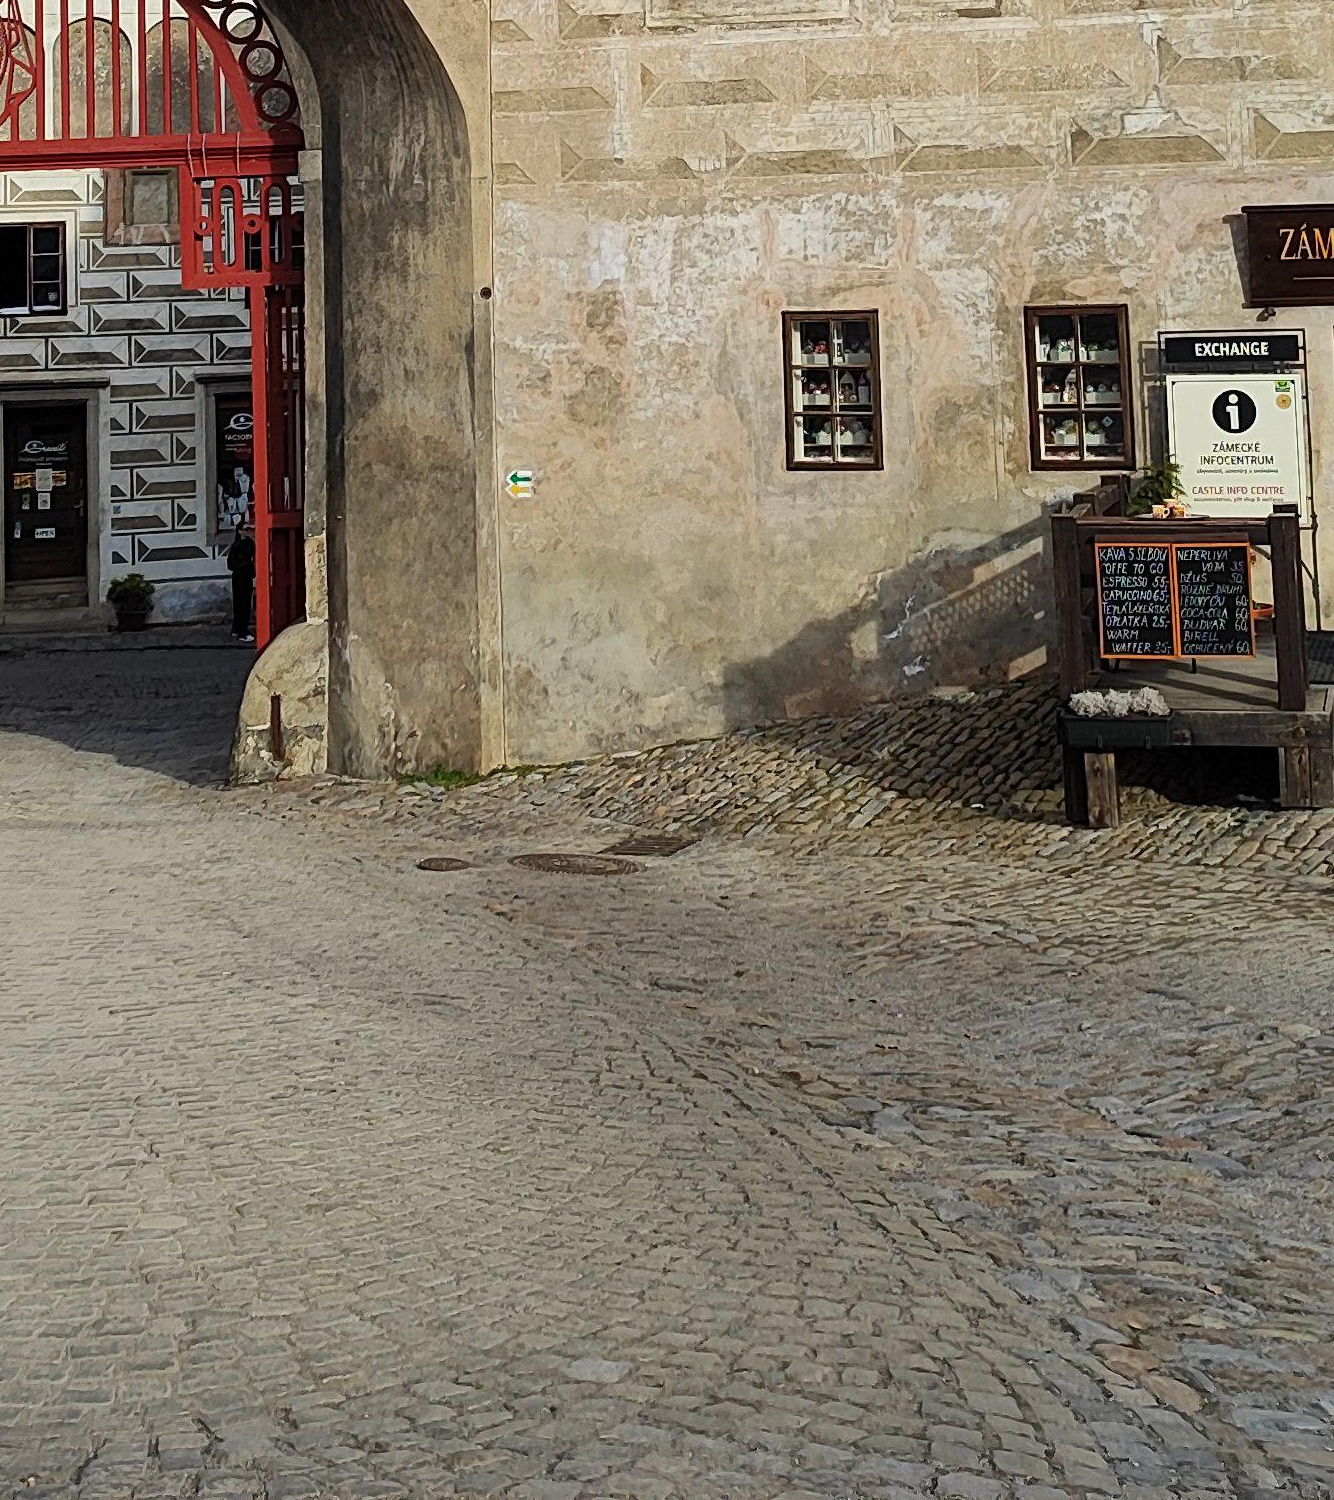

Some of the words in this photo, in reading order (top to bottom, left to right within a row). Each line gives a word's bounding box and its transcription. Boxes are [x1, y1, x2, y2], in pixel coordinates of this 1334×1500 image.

[1195, 342, 1270, 357] EXCHANGE
[1200, 455, 1274, 465] INFOCENTRUM
[1192, 486, 1224, 495] CASTLE
[1226, 486, 1248, 495] INFO
[1250, 486, 1285, 495] CENTRE
[1133, 563, 1145, 574] TO
[1150, 563, 1164, 574] GO
[1103, 577, 1147, 587] ESPRESSO
[1103, 589, 1152, 601] CAPUCCINO
[1106, 615, 1148, 627] OPLATKA
[1107, 629, 1139, 640] WARM
[1184, 631, 1219, 641] BIRELL
